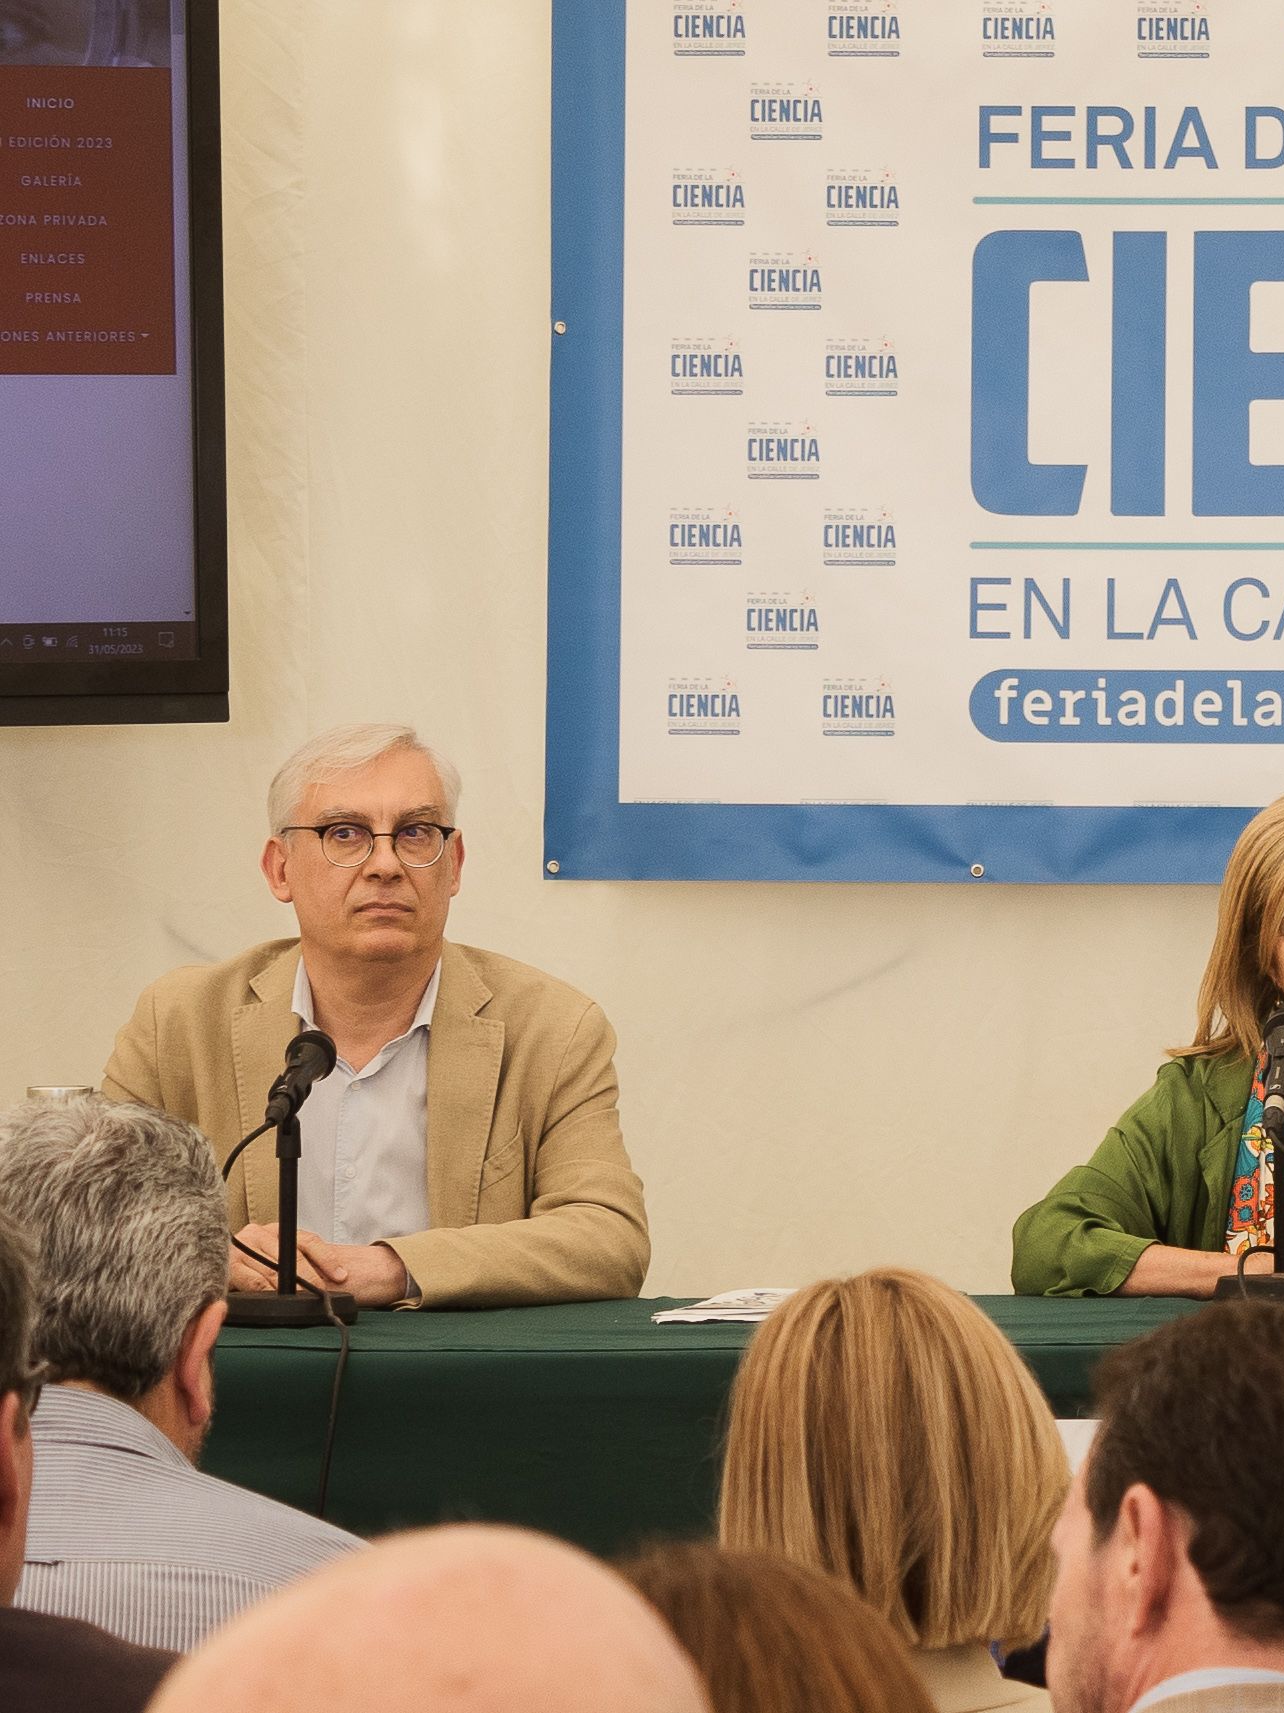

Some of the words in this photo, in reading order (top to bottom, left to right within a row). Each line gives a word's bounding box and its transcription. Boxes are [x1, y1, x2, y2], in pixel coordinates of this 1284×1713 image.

[673, 14, 746, 38] CIENCIA
[828, 15, 901, 39] CIENCIA
[982, 17, 1055, 41] CIENCIA
[1137, 17, 1210, 41] CIENCIA
[26, 97, 75, 109] INICIO
[750, 99, 823, 123] CIENCIA
[8, 134, 71, 149] EDICIÓN
[76, 137, 113, 149] 2023
[979, 106, 1218, 169] FERIA
[20, 172, 82, 187] GALERÍA
[672, 184, 745, 208] CIENCIA
[826, 185, 899, 209] CIENCIA
[43, 214, 108, 226] PRIVADA
[20, 252, 86, 265] ENLACES
[749, 268, 822, 292] CIENCIA
[25, 292, 81, 304] PRENSA
[46, 331, 136, 343] ANTERIORES
[671, 354, 744, 378] CIENCIA
[825, 355, 898, 379] CIENCIA
[748, 438, 821, 462] CIENCIA
[670, 523, 743, 547] CIENCIA
[824, 524, 897, 548] CIENCIA
[746, 608, 819, 632] CIENCIA
[970, 578, 1070, 639] EN
[1107, 578, 1197, 640] LA
[102, 627, 129, 638] 11:15
[88, 643, 144, 655] 31/05/2023
[668, 693, 741, 717] CIENCIA
[823, 694, 896, 718] CIENCIA
